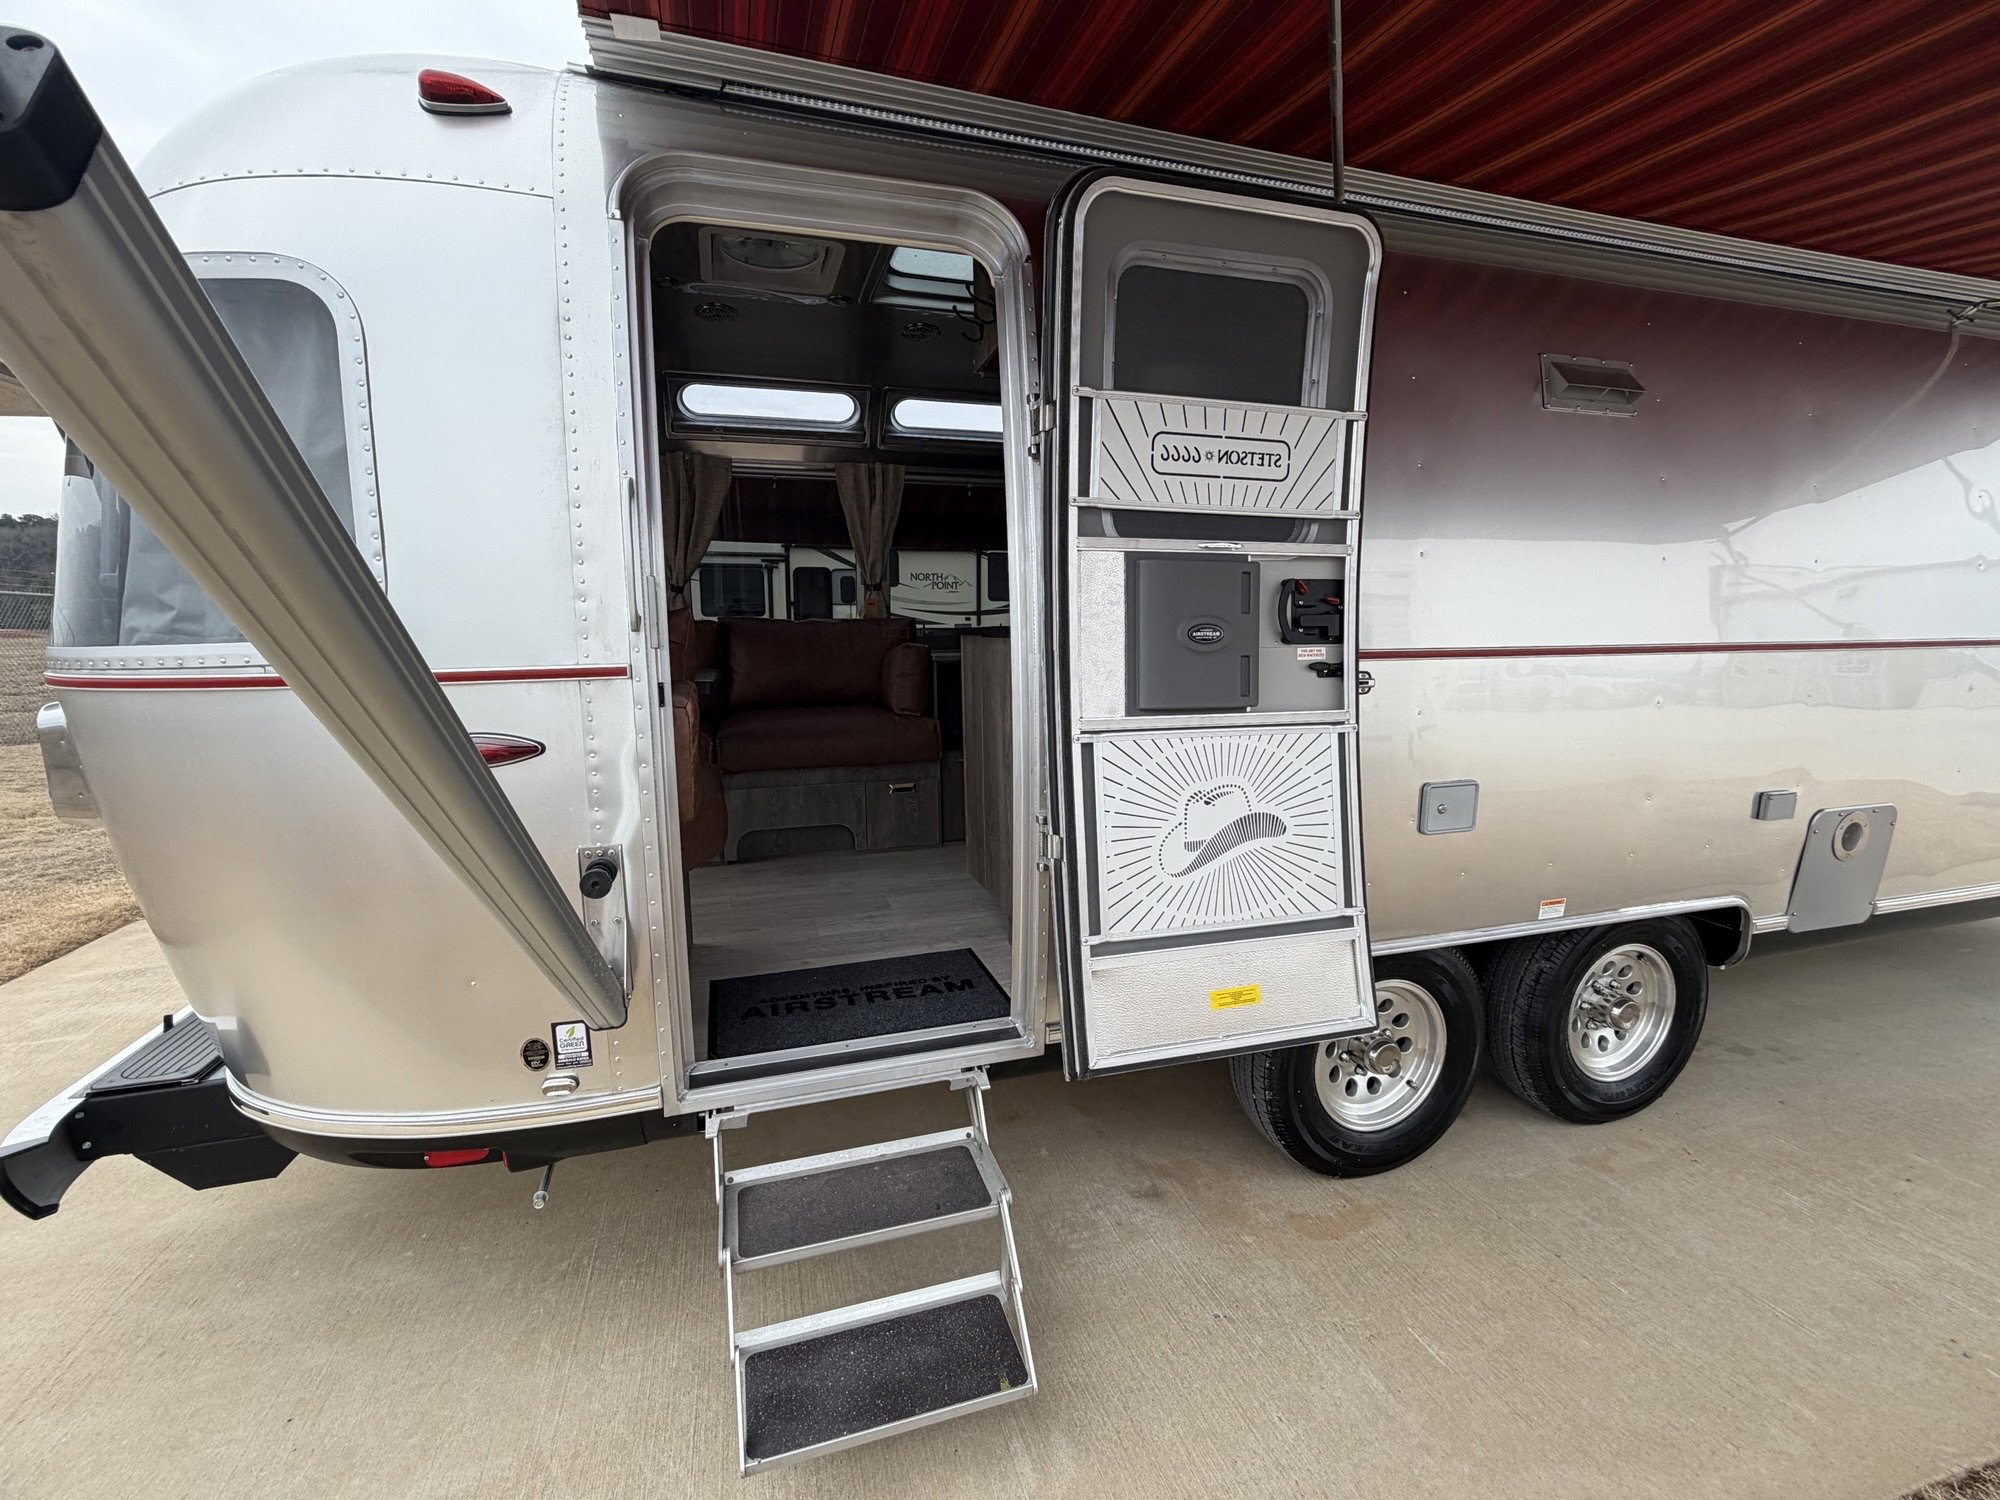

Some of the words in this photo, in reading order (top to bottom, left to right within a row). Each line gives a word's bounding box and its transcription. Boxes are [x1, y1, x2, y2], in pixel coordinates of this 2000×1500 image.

[910, 572, 943, 581] NORTH
[931, 581, 959, 590] POINT
[931, 974, 951, 983] BY
[741, 979, 975, 1020] AIRSTREAM
